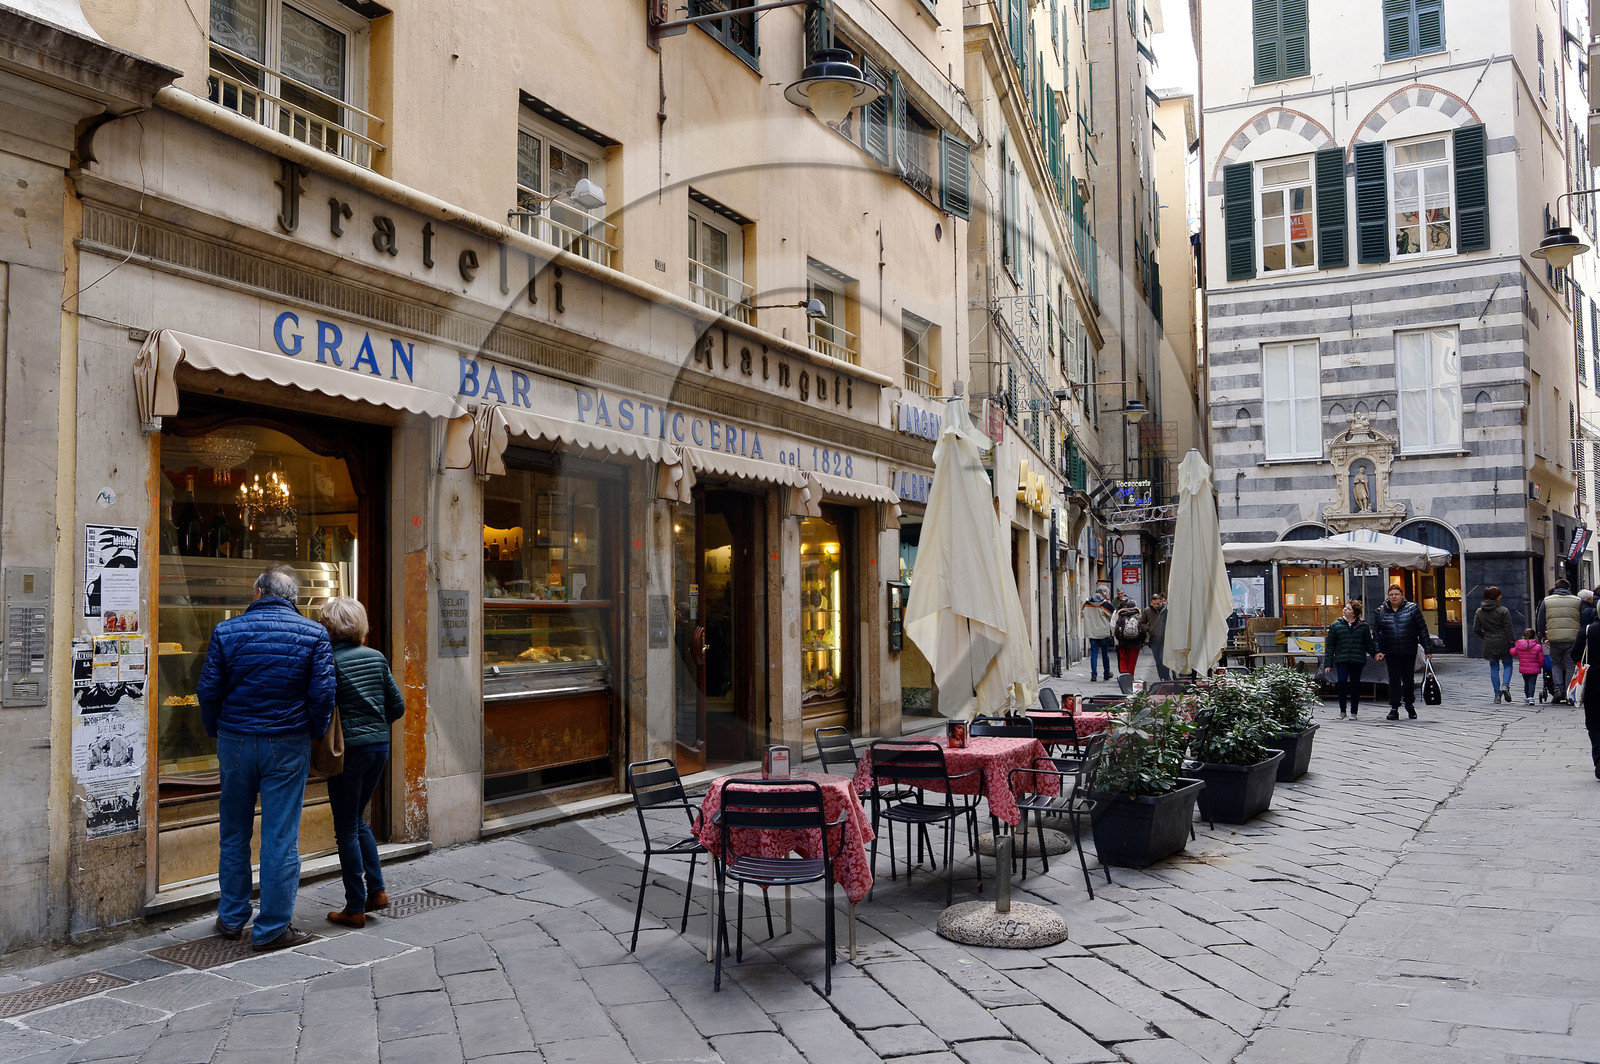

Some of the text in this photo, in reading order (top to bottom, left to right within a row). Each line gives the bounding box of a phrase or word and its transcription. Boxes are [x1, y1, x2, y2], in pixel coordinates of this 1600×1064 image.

[273, 310, 413, 381] GRAN
[459, 355, 531, 407] BAR
[576, 388, 764, 460] PASTICCERIA
[812, 446, 854, 478] 1828
[443, 598, 465, 607] GELATI
[440, 609, 468, 618] SEMIFREDDI
